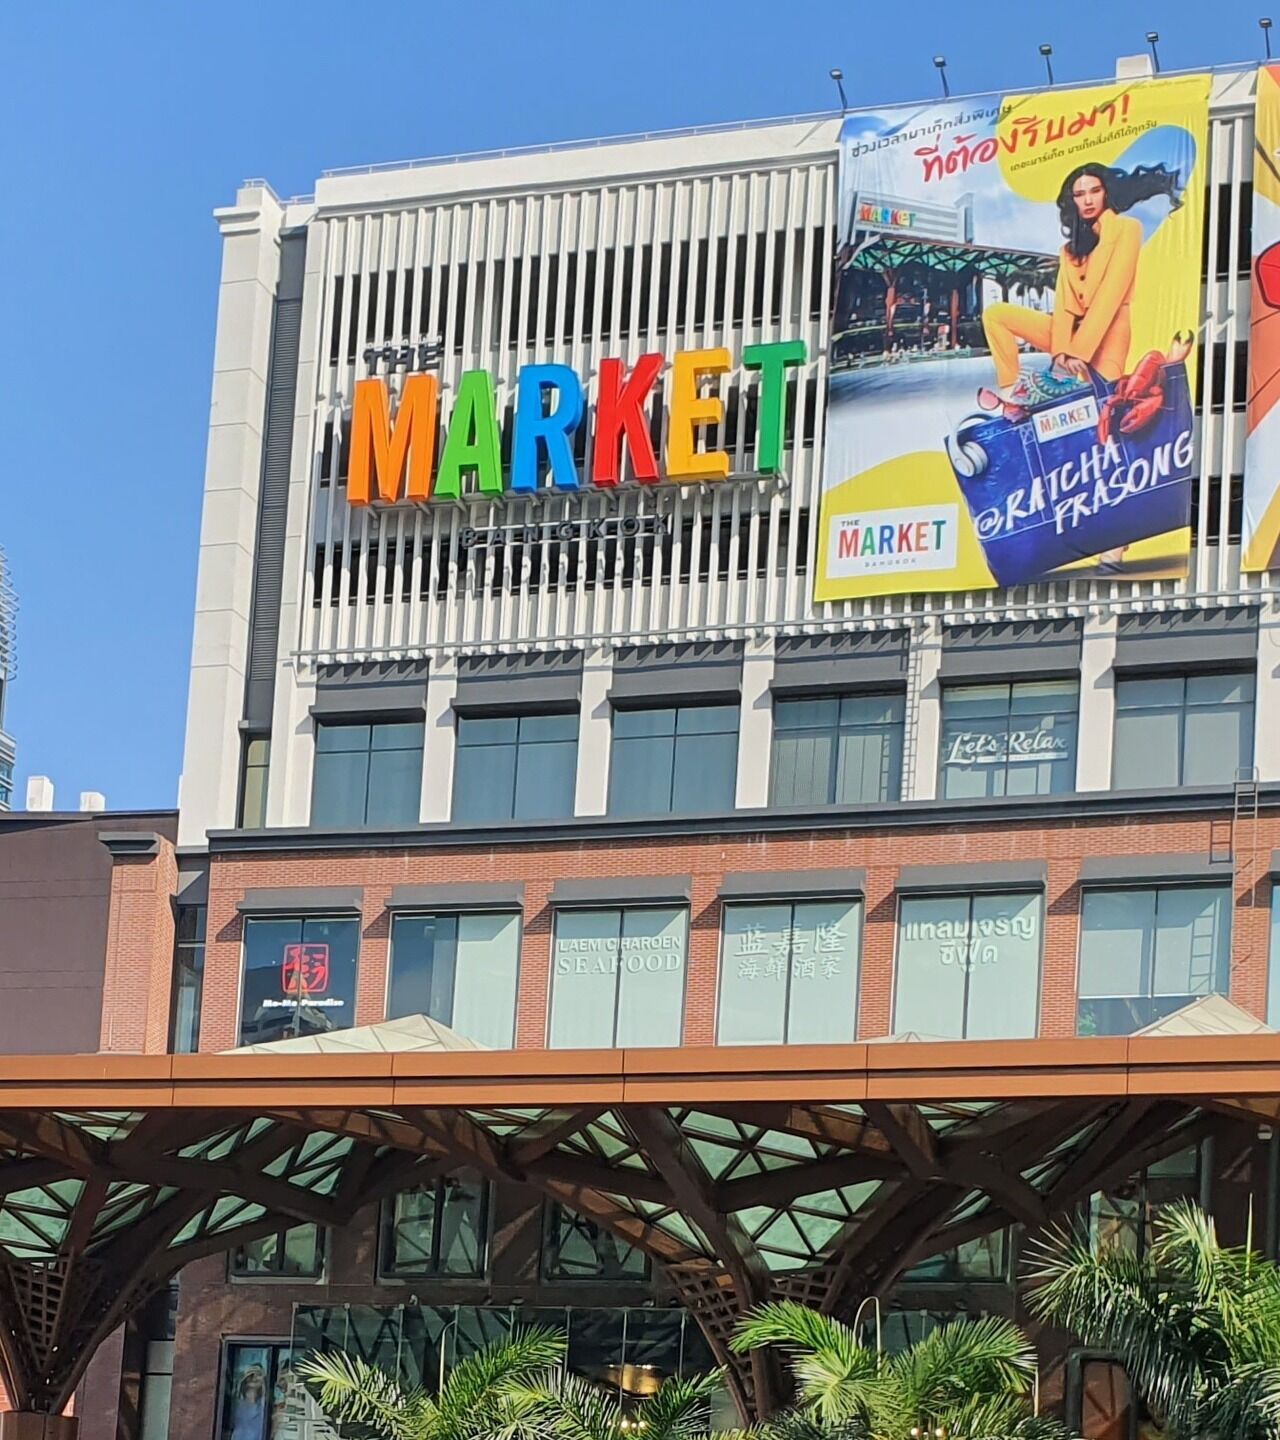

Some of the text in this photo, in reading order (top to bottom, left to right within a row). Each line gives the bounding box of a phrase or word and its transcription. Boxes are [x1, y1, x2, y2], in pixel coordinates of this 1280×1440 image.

[364, 340, 443, 374] THE
[346, 340, 807, 506] MARKET
[1039, 404, 1092, 434] MARKET
[1053, 430, 1194, 534] PRASONG
[461, 513, 673, 548] BANGKOK
[838, 520, 947, 559] MARKET
[840, 519, 860, 527] THE
[864, 558, 917, 568] BANGKOK
[944, 730, 1068, 764] Let's Relax
[558, 934, 683, 953] LAEM CHAROEN
